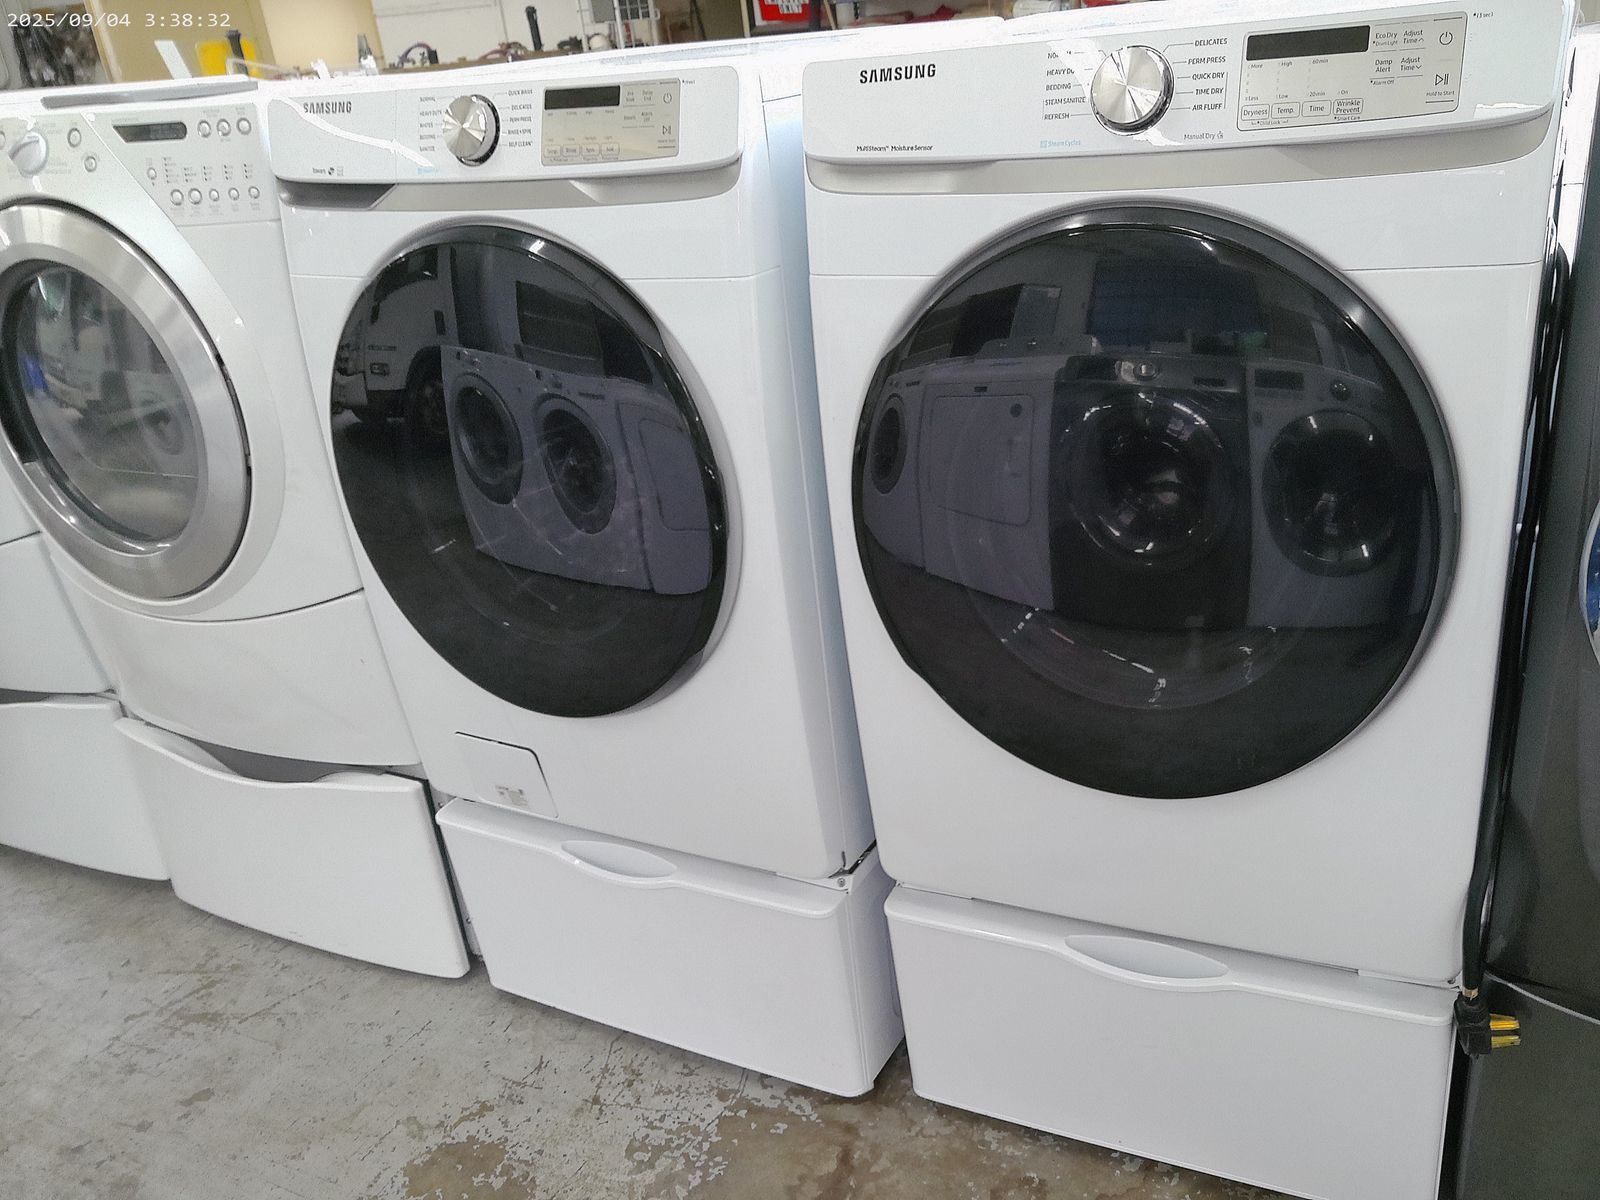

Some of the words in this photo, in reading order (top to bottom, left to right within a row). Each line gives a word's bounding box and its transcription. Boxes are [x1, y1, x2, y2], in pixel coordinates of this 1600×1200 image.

[1403, 29, 1423, 37] Adjust
[1194, 38, 1228, 47] DELICATES
[1206, 56, 1226, 64] PRESS
[859, 64, 936, 84] SAMSUNG
[1046, 68, 1067, 77] HEAVY
[1191, 73, 1212, 81] QUICK
[1045, 83, 1072, 91] BEDDING
[1195, 88, 1210, 96] TIME
[1210, 87, 1224, 95] DRY
[1063, 97, 1086, 105] SANITIZE
[303, 101, 352, 115] SAMSUNG
[1277, 107, 1294, 115] Temp.
[1044, 113, 1070, 121] REFRESH
[1243, 108, 1268, 118] Dryness
[1205, 132, 1215, 140] Dry
